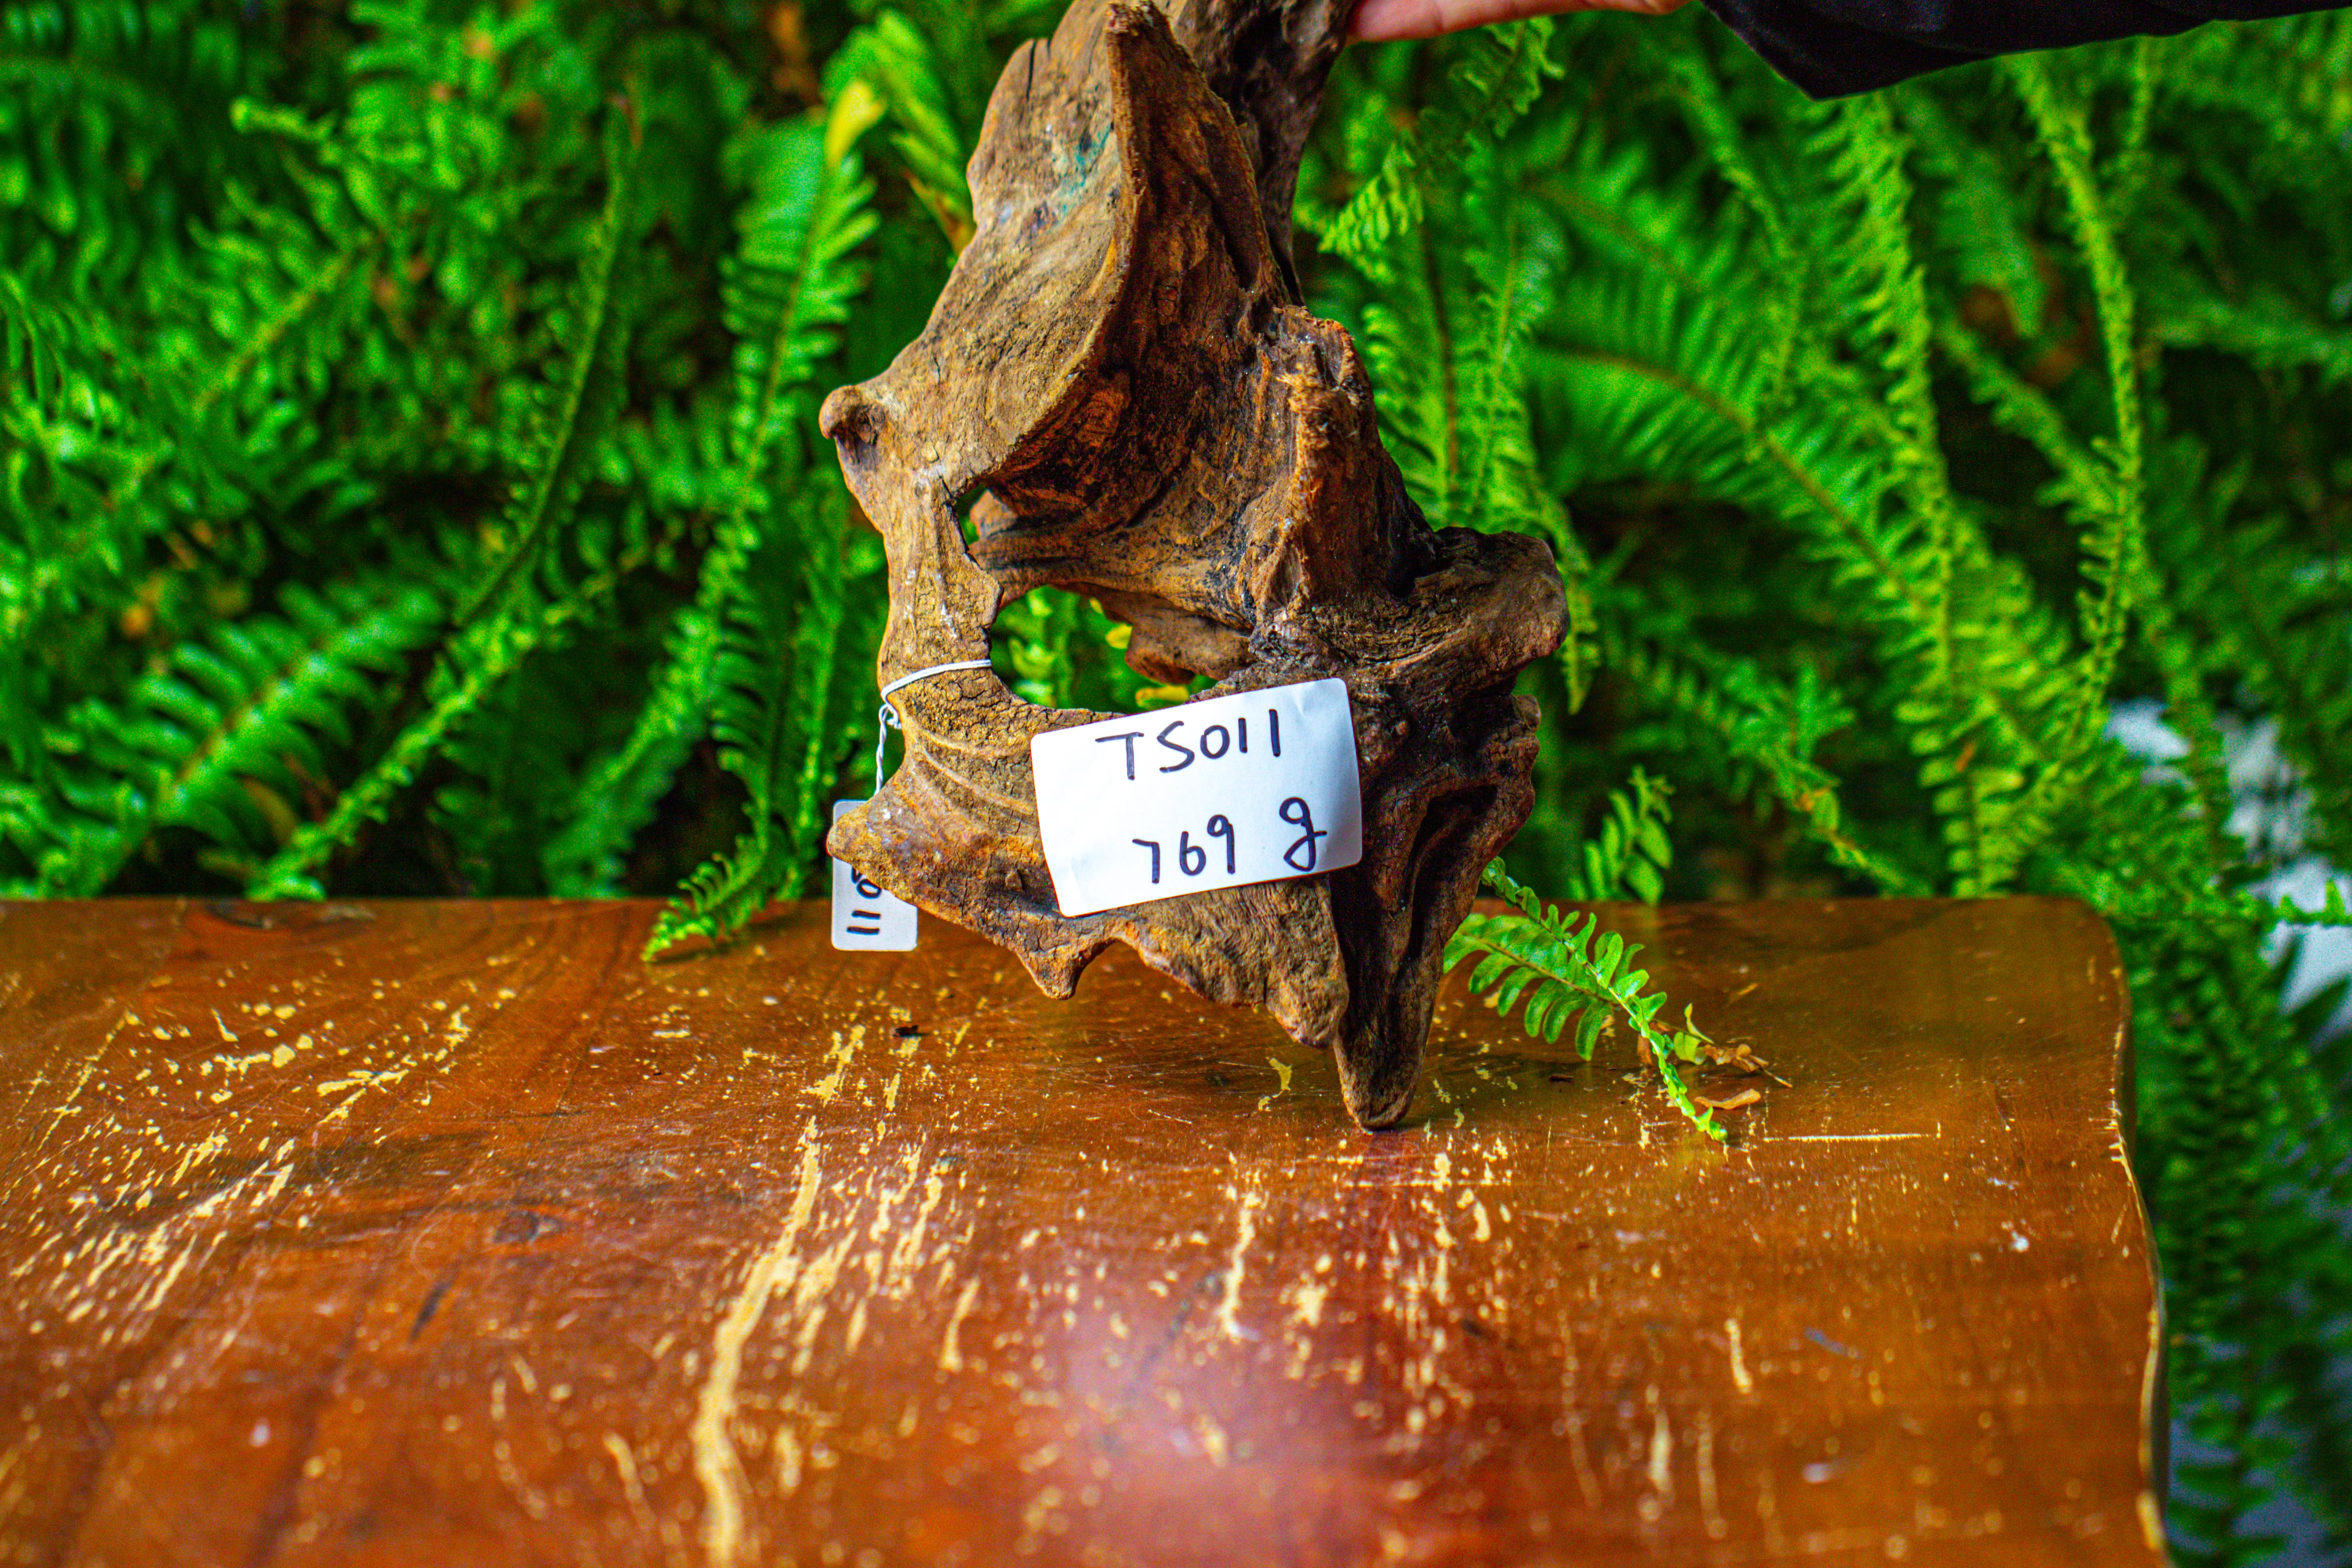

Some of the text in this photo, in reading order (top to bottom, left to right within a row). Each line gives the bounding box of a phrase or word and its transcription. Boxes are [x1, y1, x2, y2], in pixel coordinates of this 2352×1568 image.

[1095, 709, 1281, 780] TS011
[1132, 796, 1327, 883] 769 g
